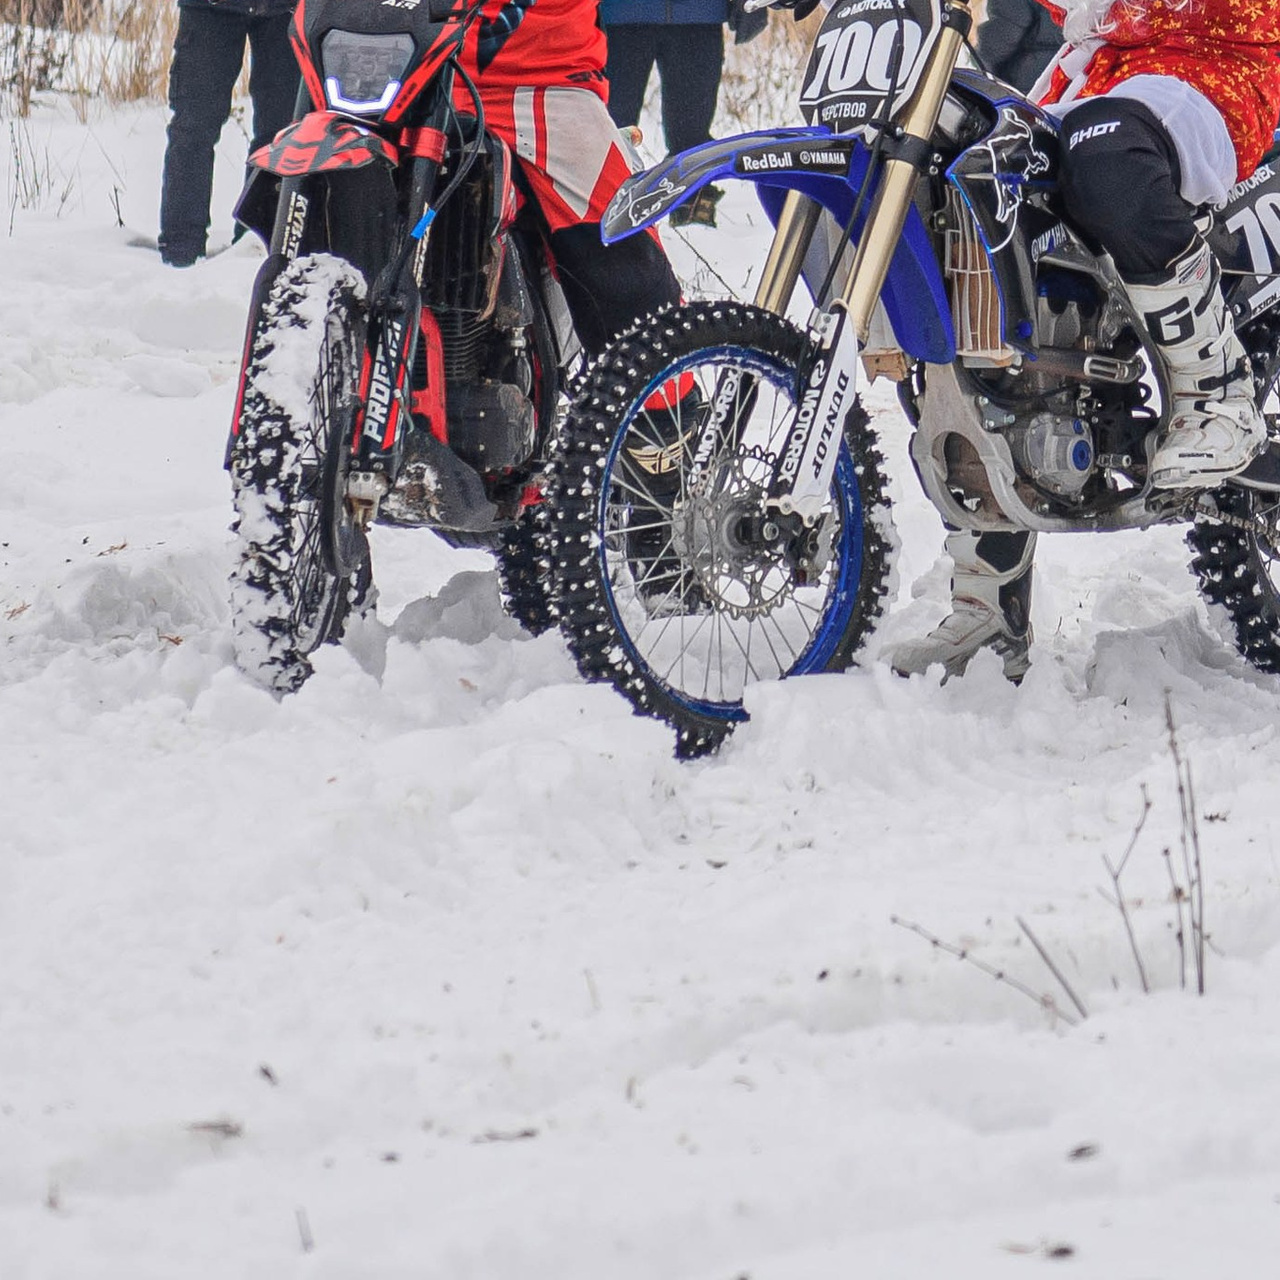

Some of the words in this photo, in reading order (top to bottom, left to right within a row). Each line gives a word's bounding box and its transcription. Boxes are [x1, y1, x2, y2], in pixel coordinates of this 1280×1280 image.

[1069, 121, 1120, 150] SHOT
[742, 154, 769, 171] Red
[767, 152, 793, 169] Bull
[809, 151, 846, 166] YAMAHA
[1225, 164, 1276, 204] MOTOREX
[777, 390, 820, 484] MOTOREX
[813, 369, 850, 481] DUNLOP
